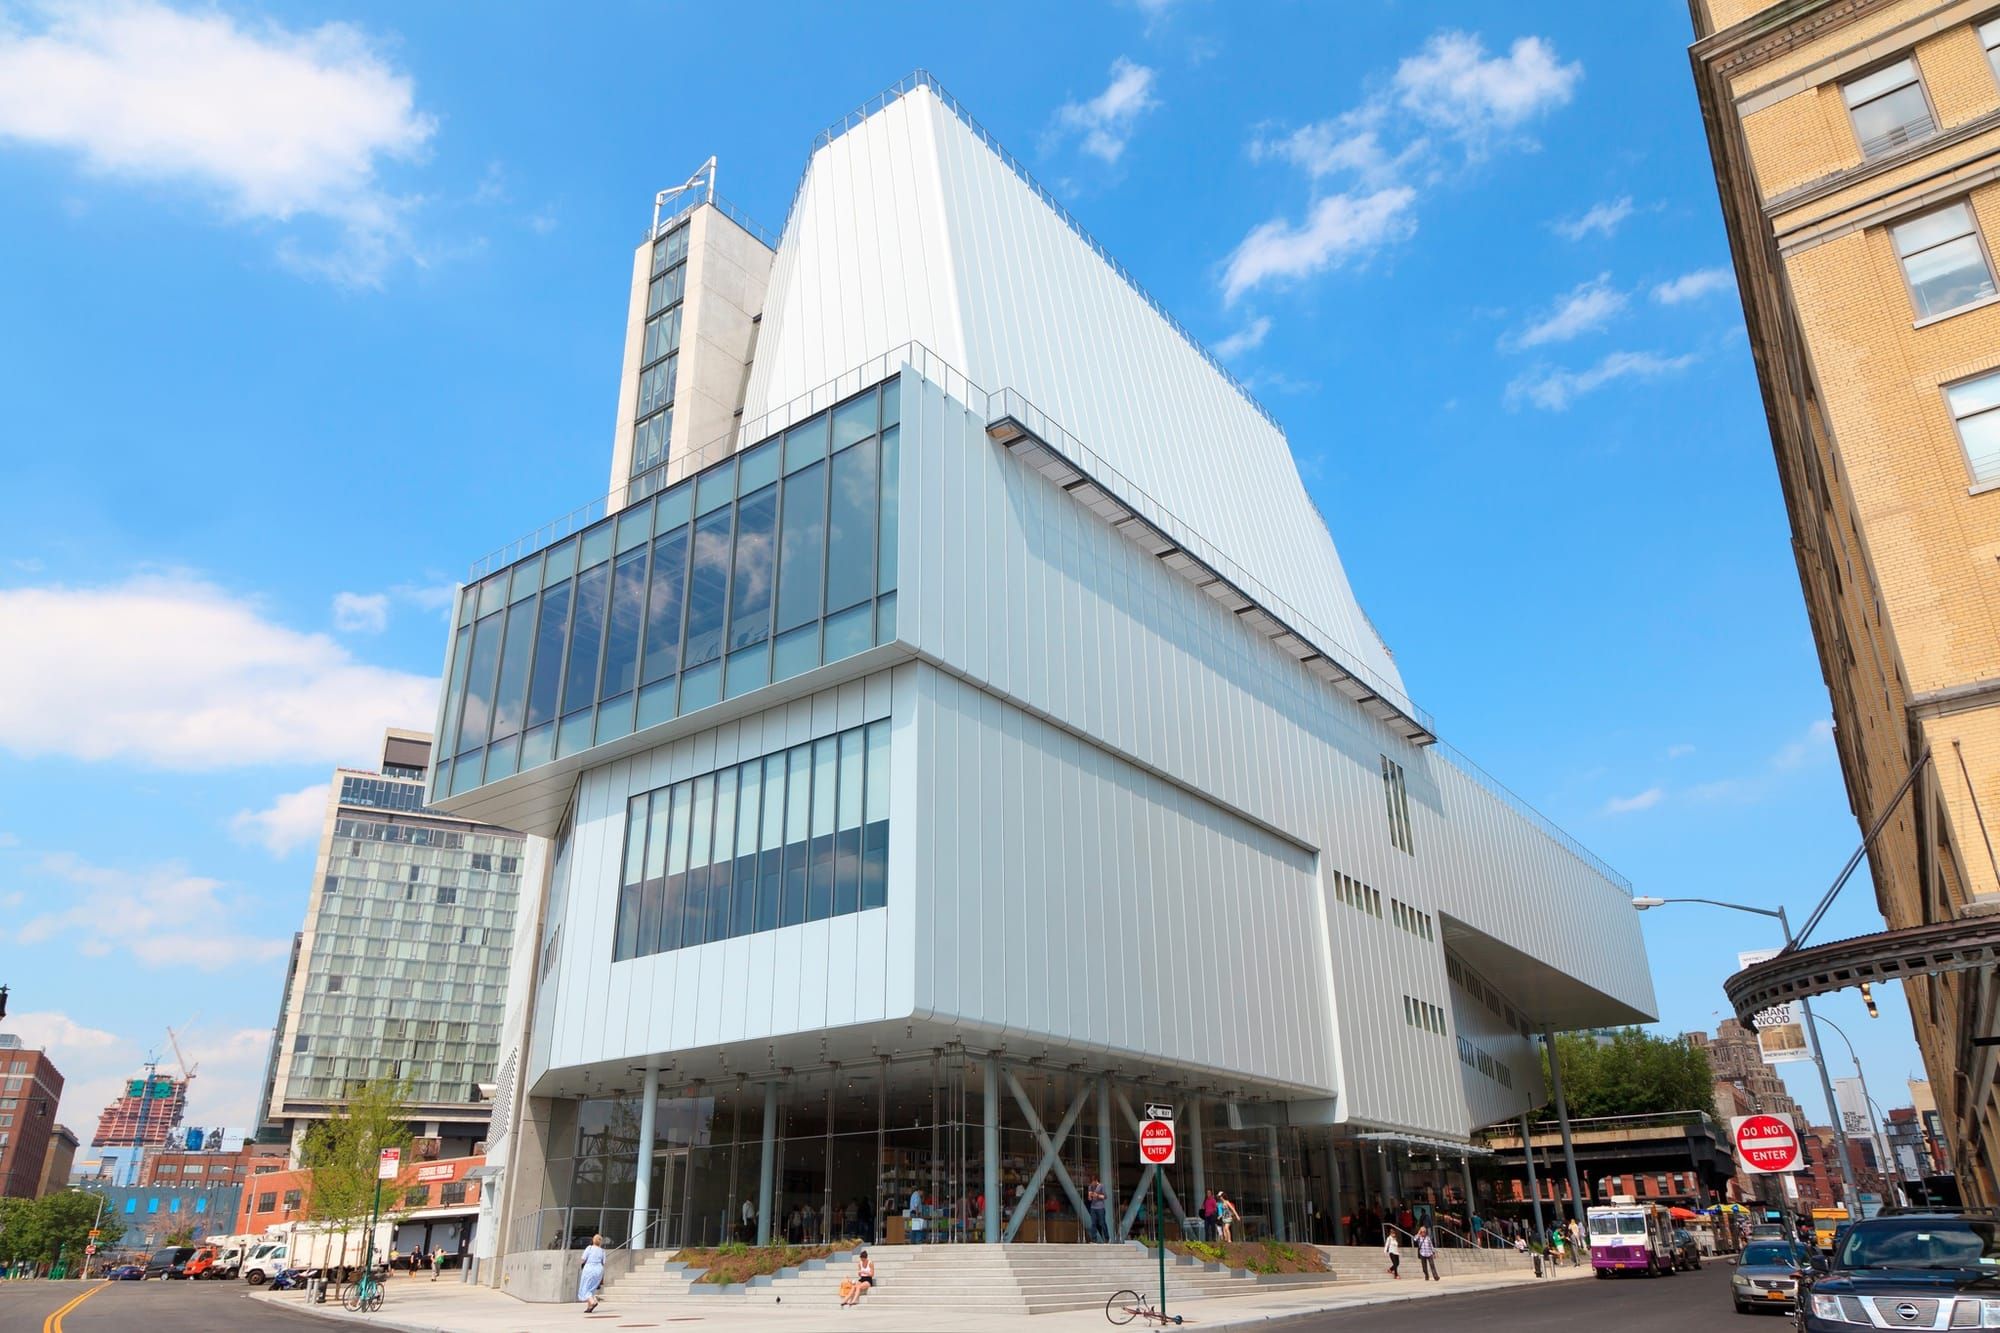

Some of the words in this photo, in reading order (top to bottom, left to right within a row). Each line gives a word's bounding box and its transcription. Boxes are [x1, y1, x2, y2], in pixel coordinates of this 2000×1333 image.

[1757, 1007, 1790, 1018] GRANT
[1756, 1015, 1790, 1025] WOOD
[1145, 1129, 1154, 1137] DO
[1156, 1129, 1167, 1137] NOT
[1743, 1127, 1758, 1137] DO
[1763, 1125, 1784, 1135] NOT
[1147, 1147, 1167, 1155] ENTER
[1752, 1150, 1787, 1161] ENTER
